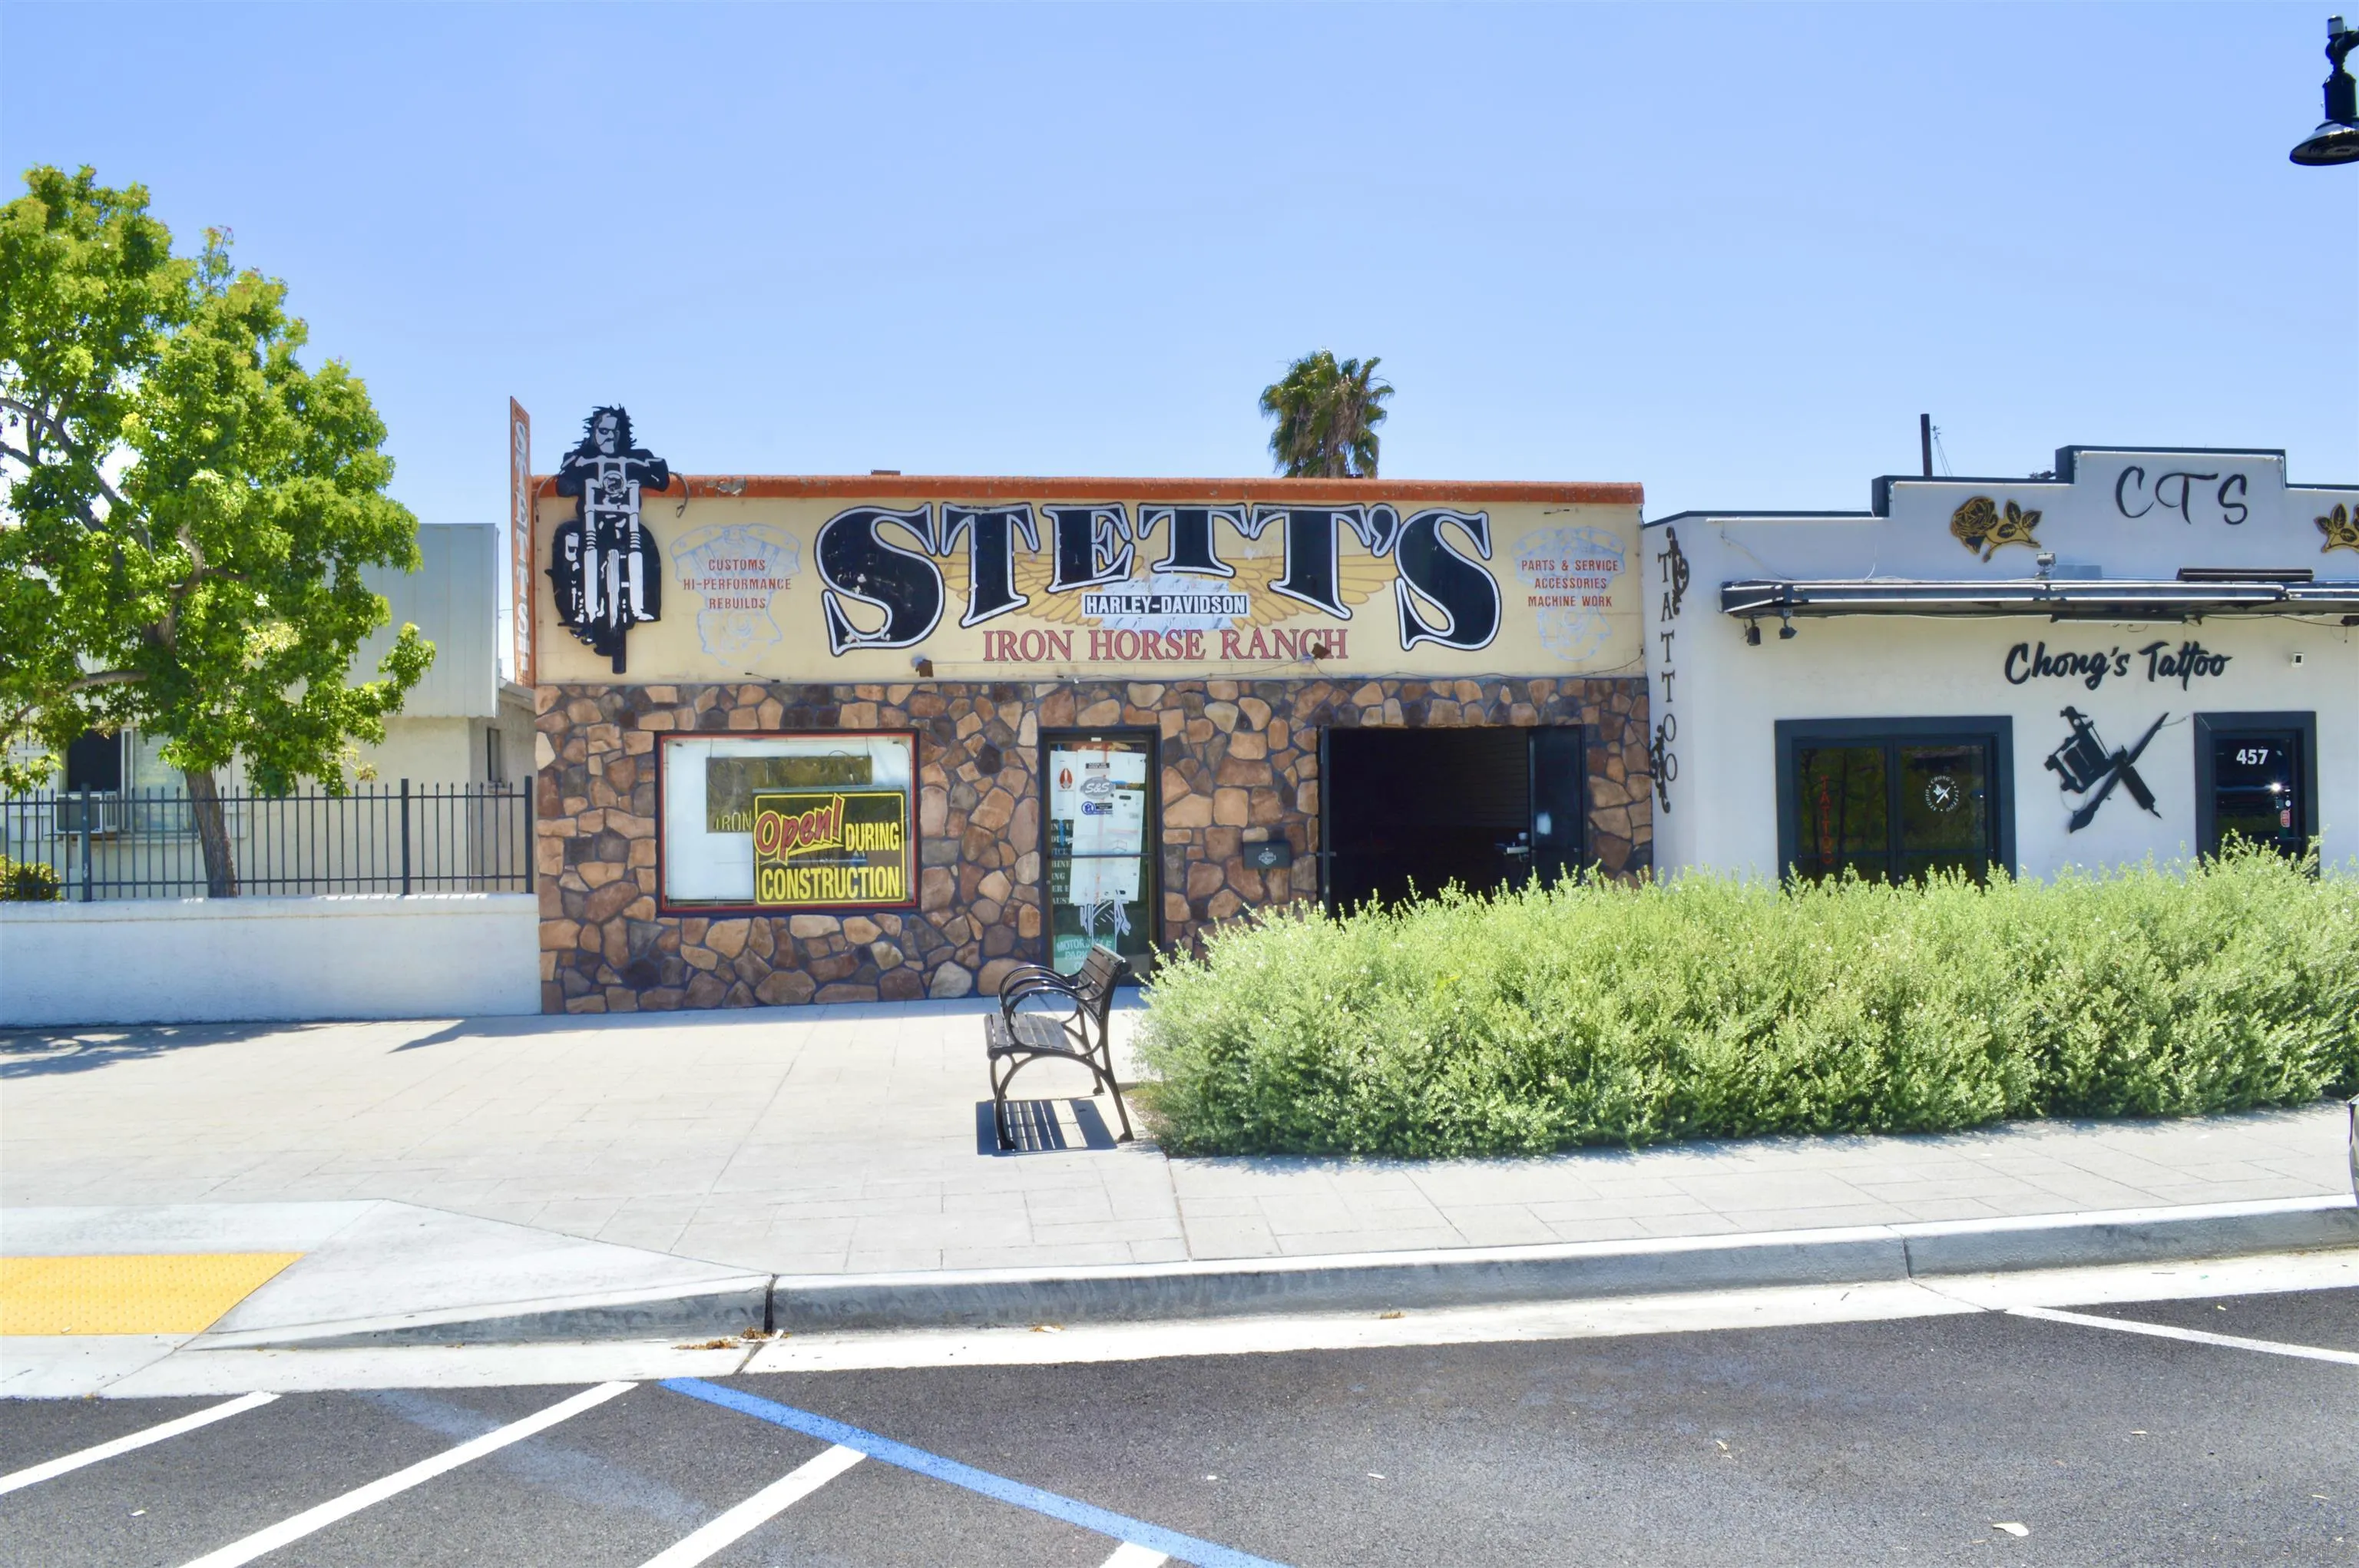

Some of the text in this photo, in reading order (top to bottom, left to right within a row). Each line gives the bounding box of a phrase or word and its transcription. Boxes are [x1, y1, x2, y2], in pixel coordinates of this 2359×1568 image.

[2116, 466, 2248, 525] CTS
[708, 559, 766, 571] CUSTOMS
[1521, 560, 1619, 571] PARTS & SERVICE
[683, 578, 792, 590] HI-PERFORMANCE
[814, 501, 1502, 657] STETT'S
[1534, 577, 1606, 589] ACCESSORIES
[709, 598, 766, 609] REBUILDS
[1087, 596, 1246, 614] HARLEY-DAVIDSON
[1528, 596, 1612, 607] MACHINE WORK
[983, 629, 1348, 662] IRON HORSE RANCH
[1658, 552, 1678, 782] TATTOO
[2004, 640, 2232, 691] Chong's Tattoo
[2236, 749, 2268, 765] 457
[1085, 782, 1110, 794] S&S
[716, 810, 752, 832] IRON
[754, 792, 900, 865] Open! DURING
[761, 866, 900, 899] CONSTRUCTION
